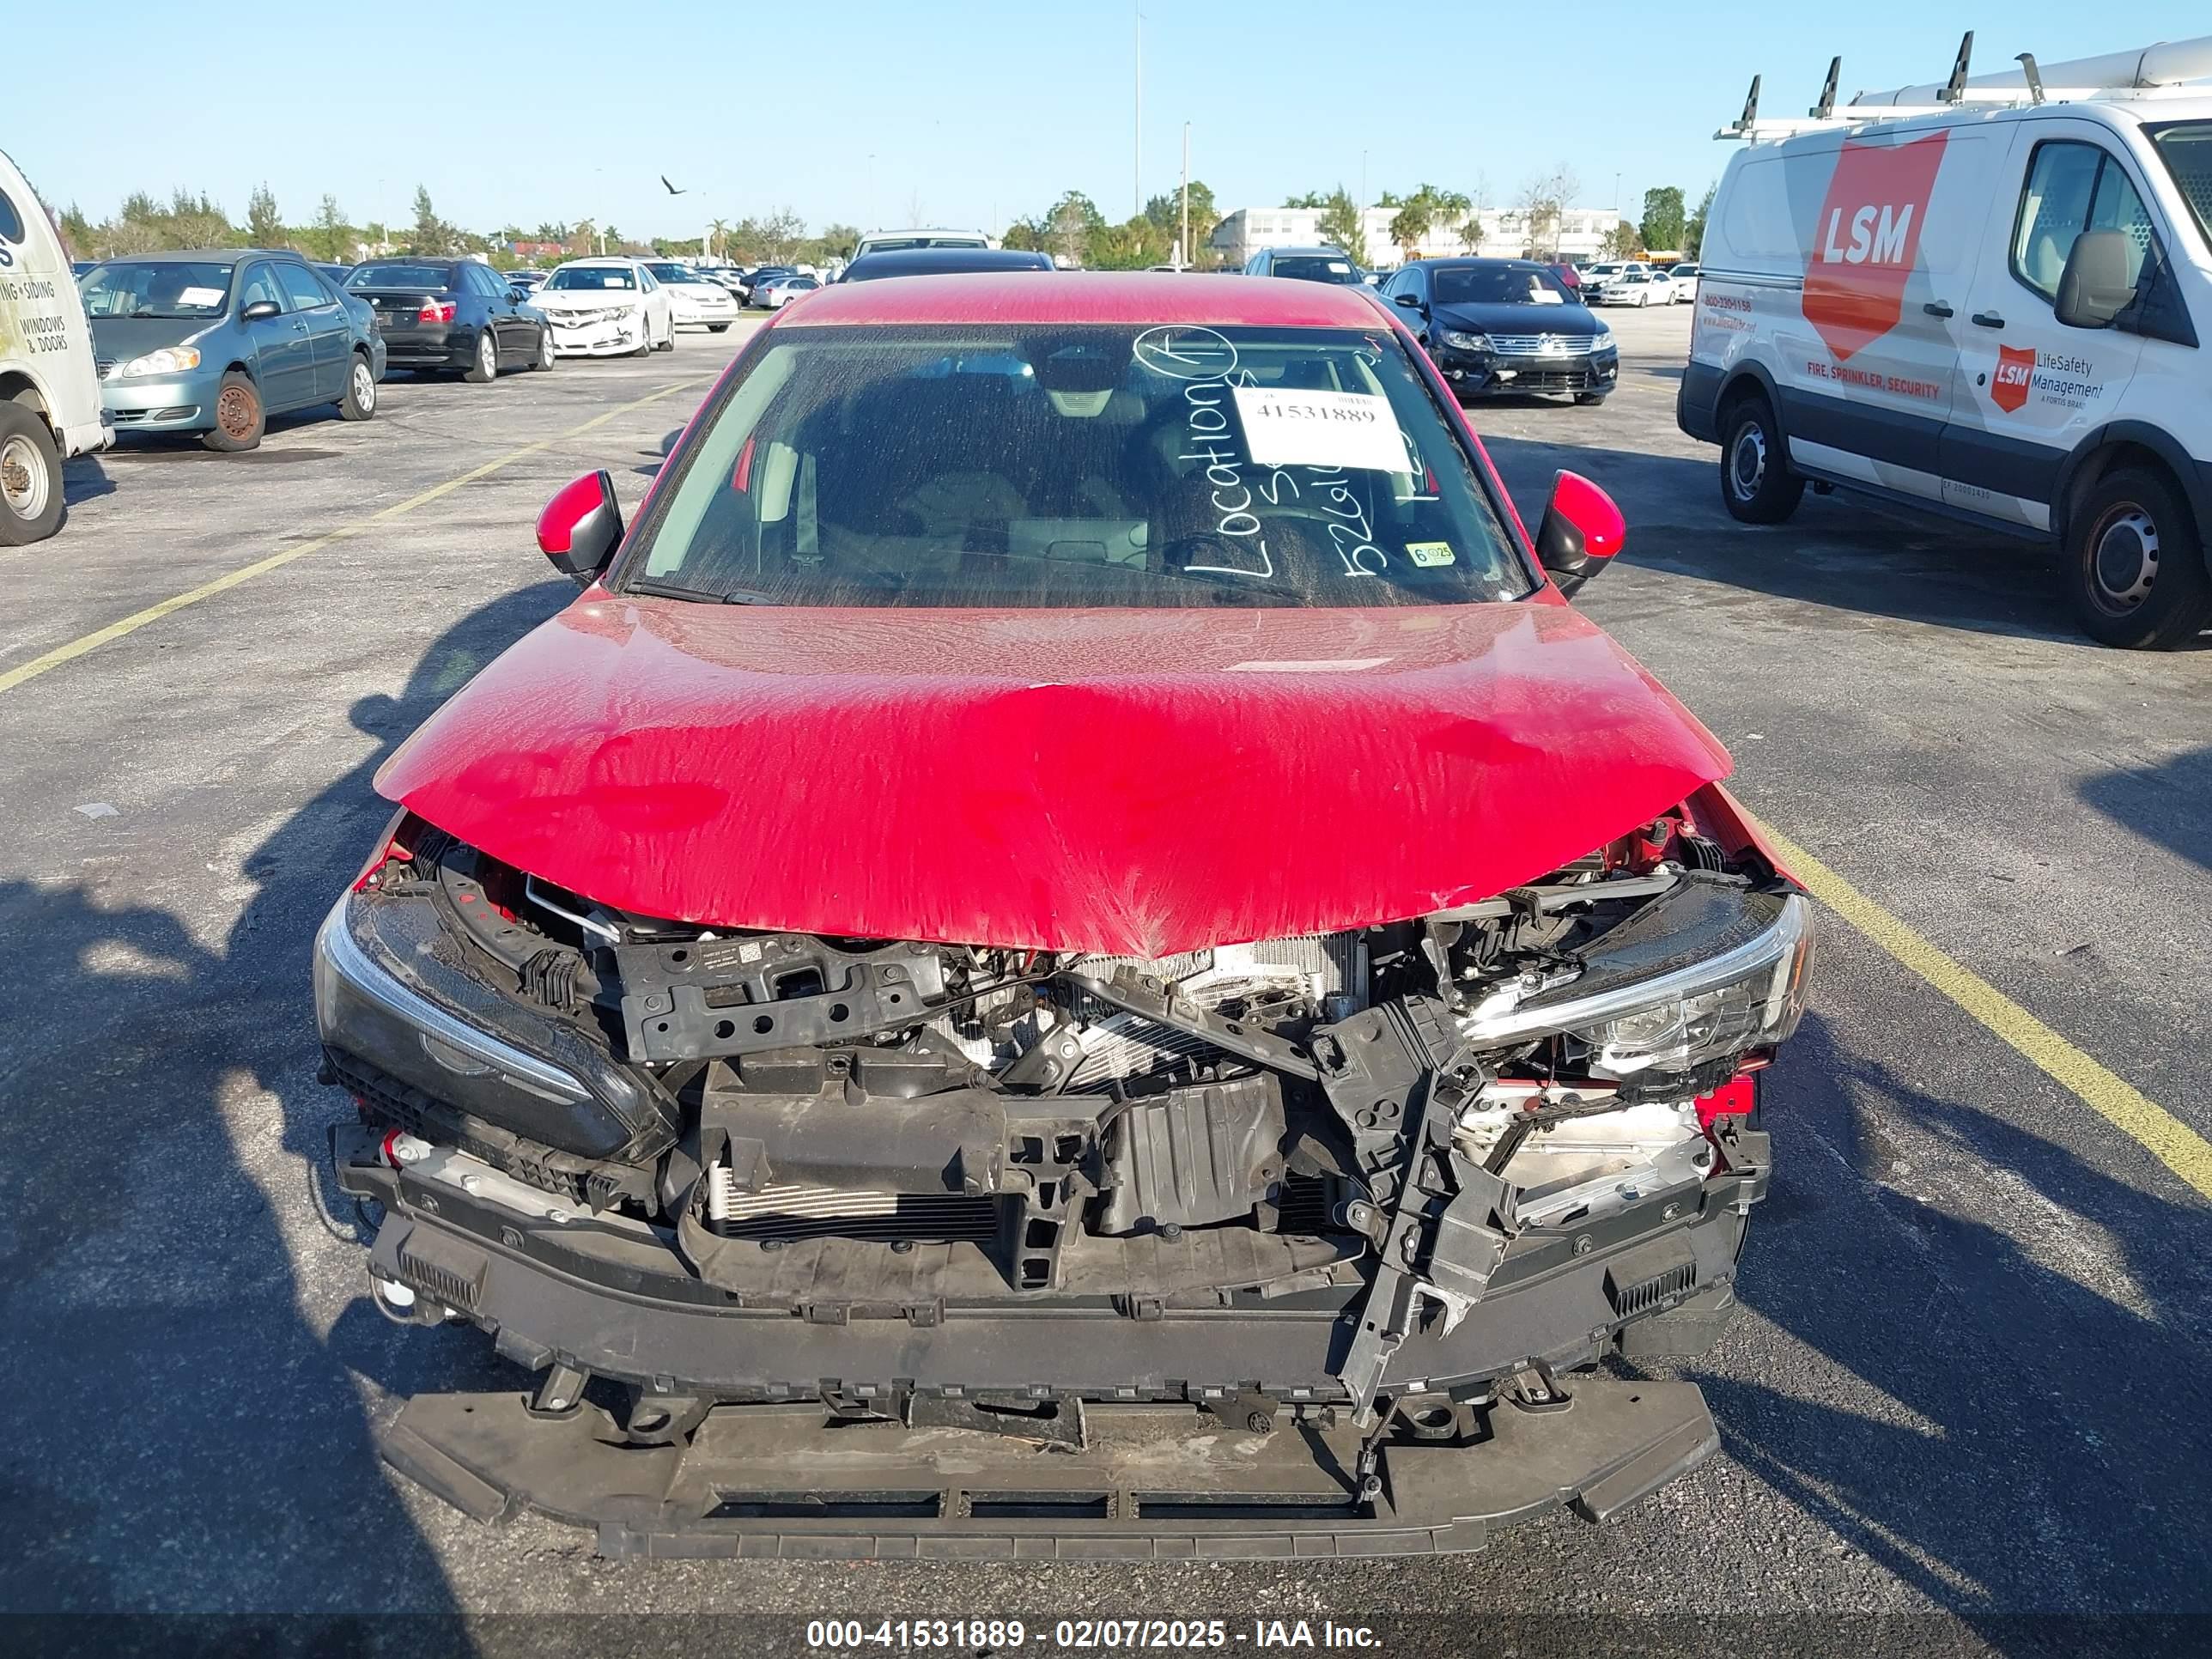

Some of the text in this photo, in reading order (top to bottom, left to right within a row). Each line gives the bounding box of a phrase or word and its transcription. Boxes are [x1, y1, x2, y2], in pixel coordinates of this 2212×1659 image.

[1823, 204, 1915, 264] LSM
[23, 281, 55, 300] SIDING
[19, 315, 66, 336] WINDOWS
[27, 335, 68, 354] & DOORS
[1996, 364, 2029, 386] LSM
[2037, 353, 2094, 378] LifeSafety
[1808, 362, 1941, 400] FIRE, SPRINKLER, SECURITY
[2031, 373, 2104, 399] Management
[2045, 395, 2067, 407] FORTIS
[1256, 404, 1376, 424] 41531889
[1178, 382, 1274, 579] Location
[1414, 546, 1451, 562] 6 25
